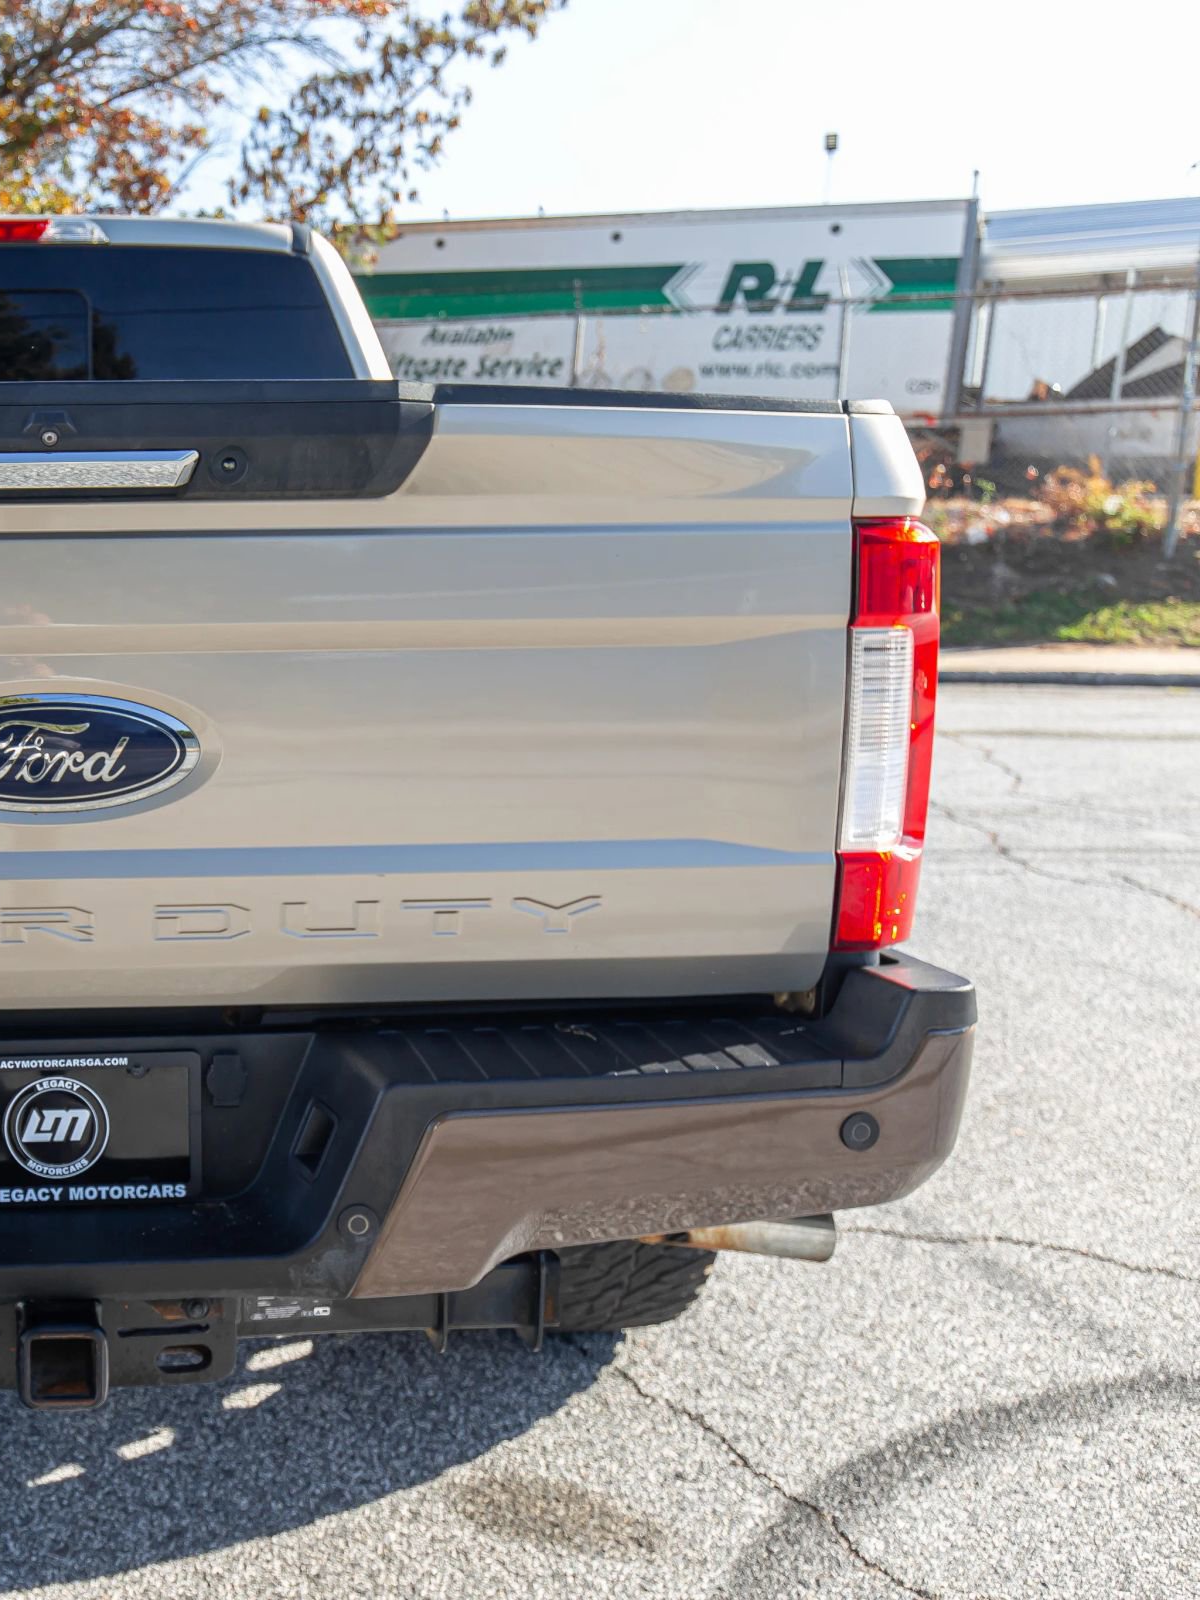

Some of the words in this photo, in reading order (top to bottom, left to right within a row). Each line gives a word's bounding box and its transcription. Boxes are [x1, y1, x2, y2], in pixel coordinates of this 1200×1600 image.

[421, 325, 515, 347] Available
[712, 323, 824, 352] CARRIERS
[473, 350, 564, 379] Service
[153, 894, 603, 942] DUTY
[35, 1080, 81, 1092] LEGACY
[26, 1158, 90, 1176] MOTORCARS
[68, 1183, 187, 1201] MOTORCARS
